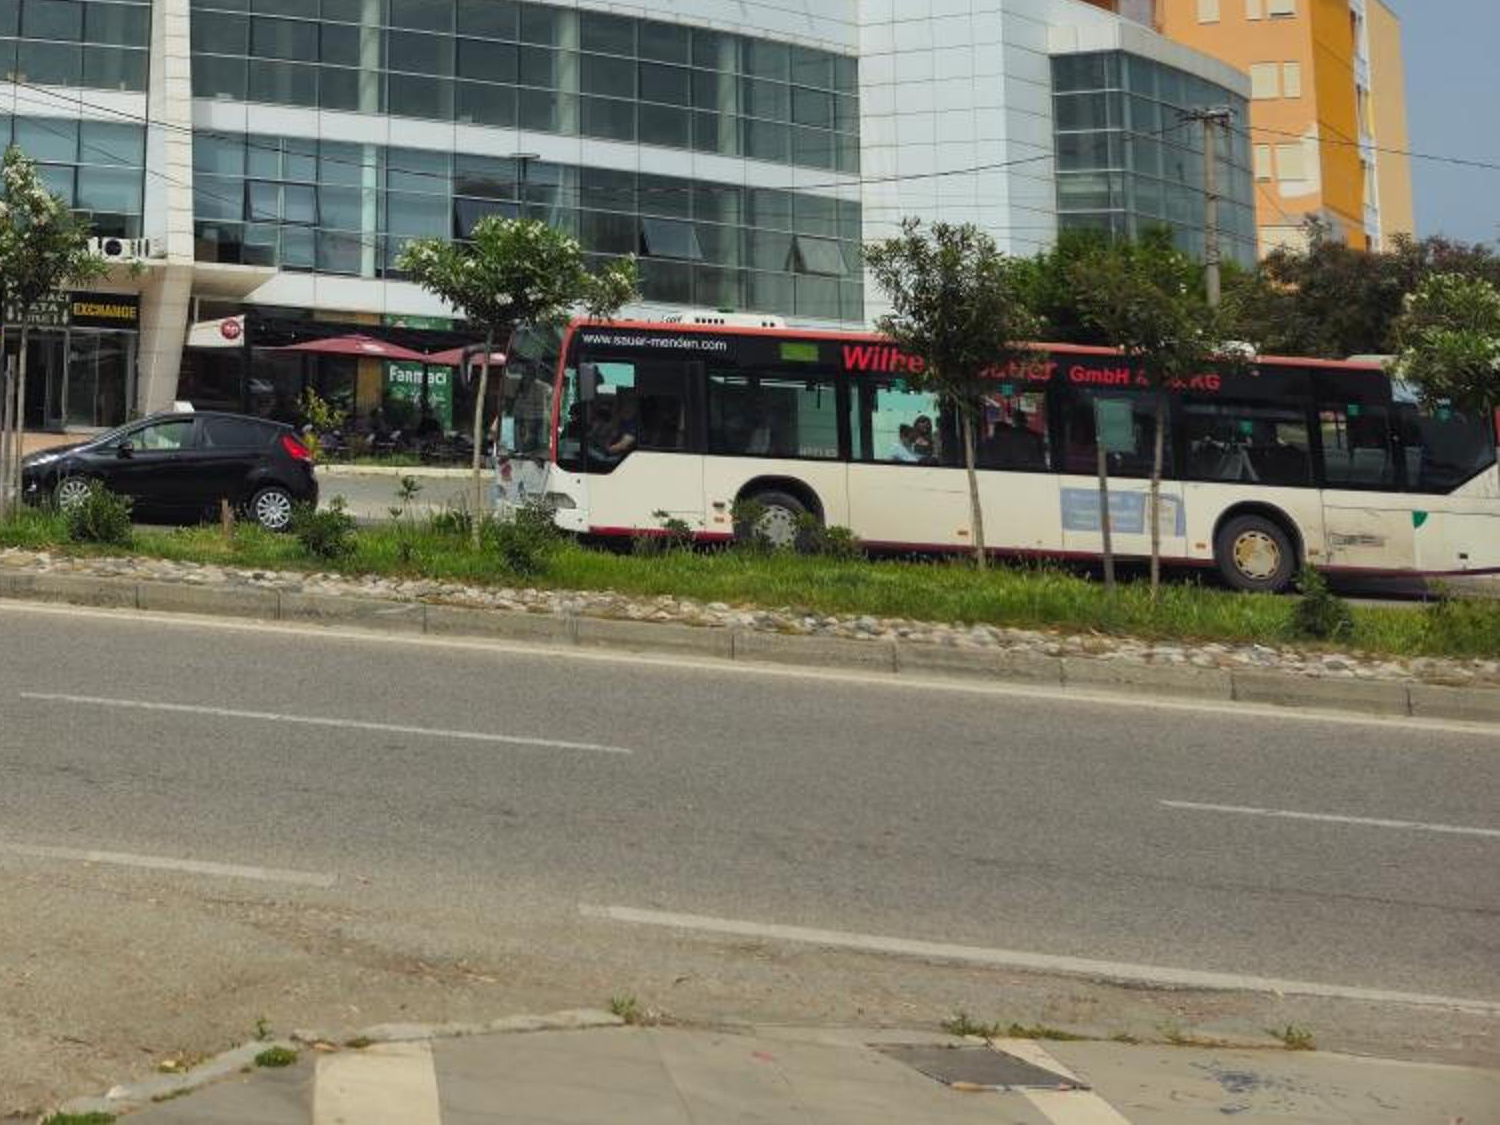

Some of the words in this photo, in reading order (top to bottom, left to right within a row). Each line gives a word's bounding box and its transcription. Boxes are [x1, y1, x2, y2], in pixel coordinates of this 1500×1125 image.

[72, 302, 138, 318] EXCHANGE
[582, 333, 727, 351] www.sauer-menden.com
[841, 345, 931, 373] Wilhe
[1069, 365, 1131, 385] GmbH
